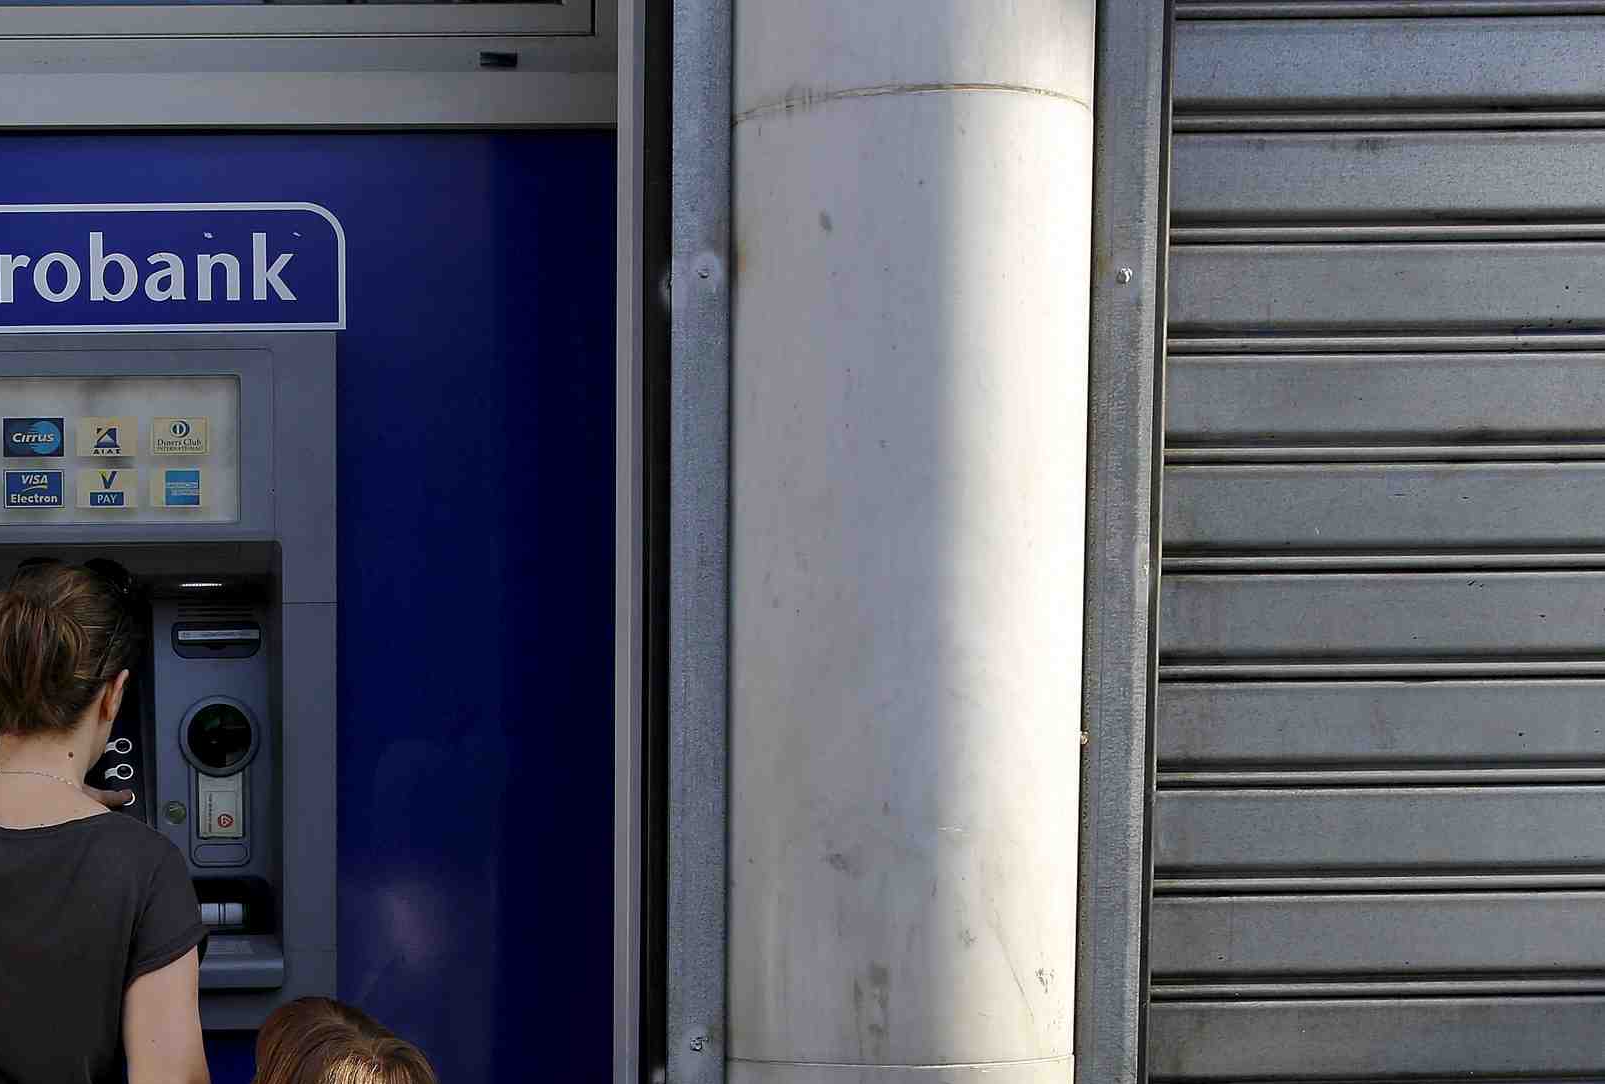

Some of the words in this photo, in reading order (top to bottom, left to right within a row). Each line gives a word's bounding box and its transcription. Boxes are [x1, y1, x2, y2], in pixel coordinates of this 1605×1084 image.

[12, 433, 54, 443] Cirrus
[21, 474, 48, 484] VISA
[10, 493, 58, 503] Electron
[97, 494, 117, 504] PAY
